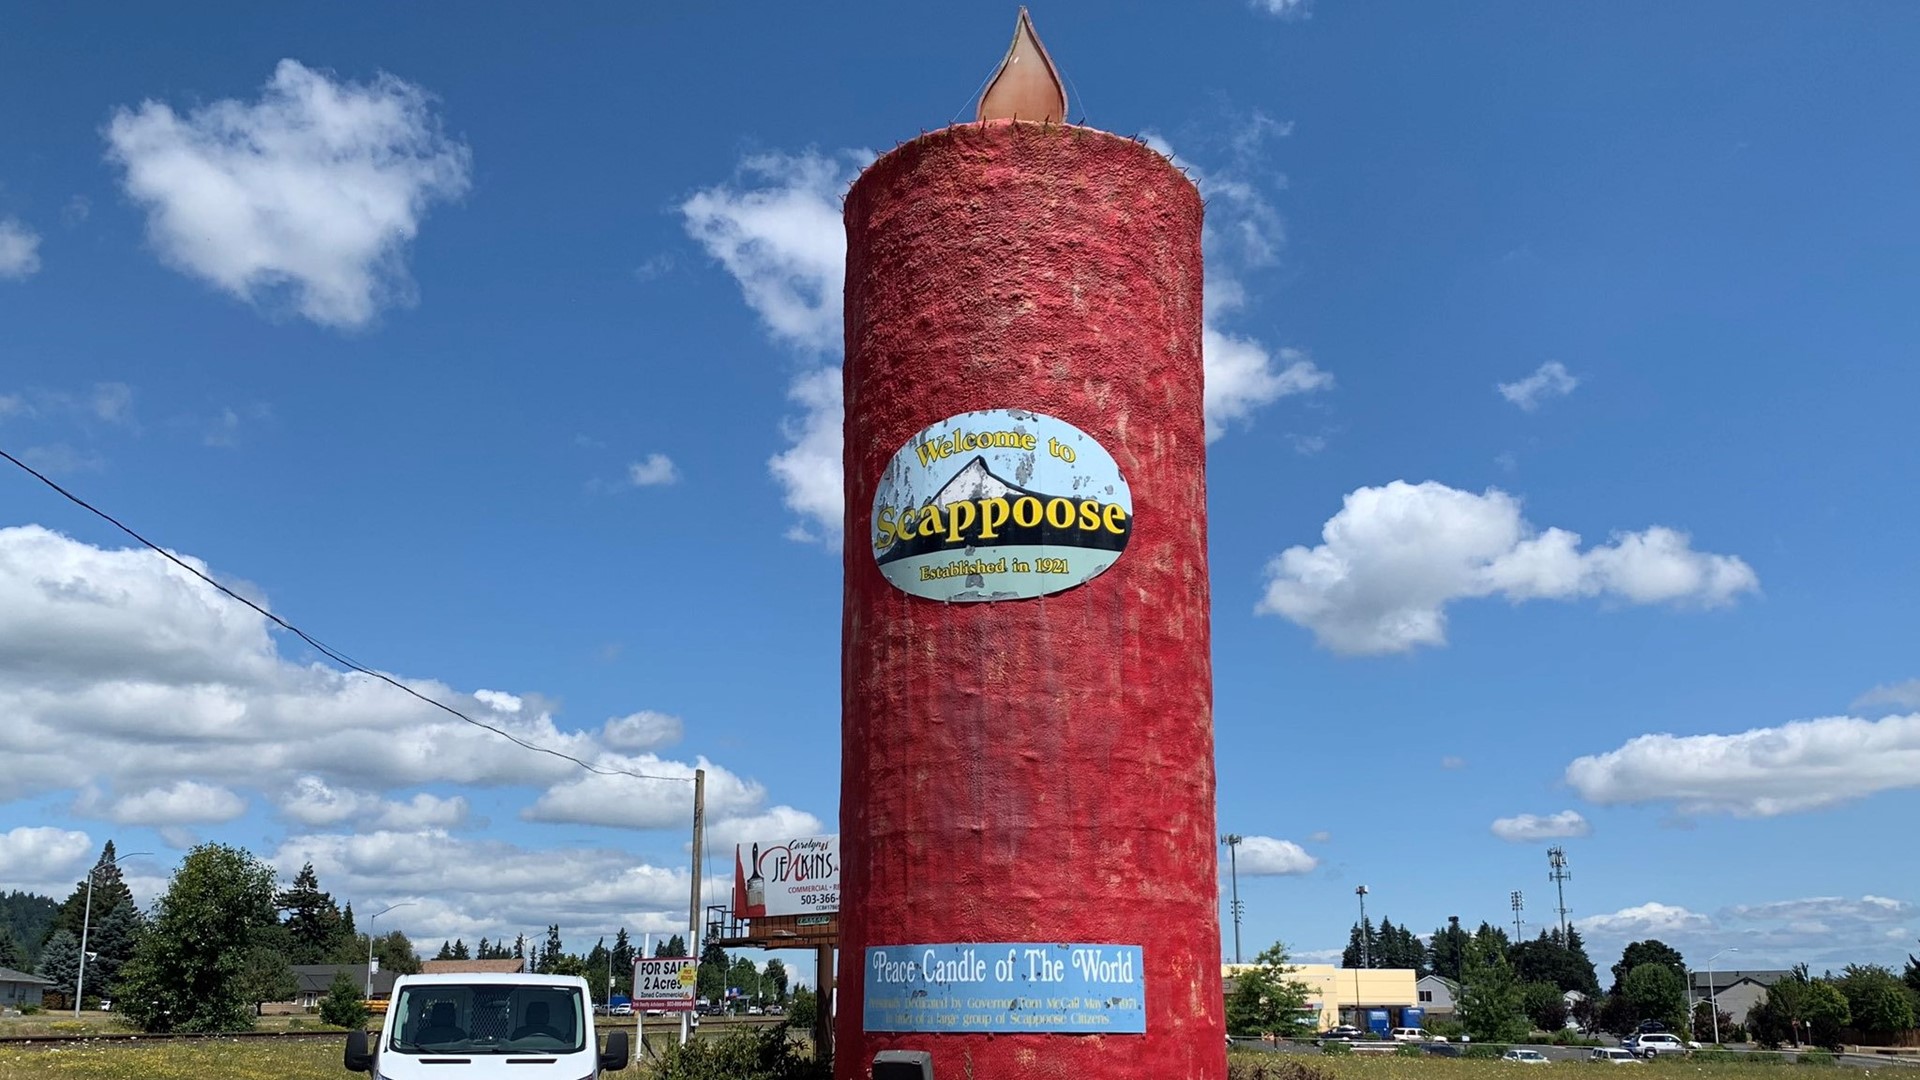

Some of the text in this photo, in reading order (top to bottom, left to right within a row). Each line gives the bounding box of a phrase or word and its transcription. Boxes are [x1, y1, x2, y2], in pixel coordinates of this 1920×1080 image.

[915, 428, 1077, 468] Welcome to
[875, 495, 1126, 549] Scappoose
[919, 558, 1070, 582] Established in 1921
[764, 847, 833, 882] JENKINS
[788, 885, 828, 894] COMMERCIAL
[641, 962, 661, 975] FOR
[872, 948, 1134, 983] Peace Candle of The World
[644, 976, 650, 990] 2
[652, 976, 682, 990] Acres
[951, 997, 962, 1011] by
[1047, 997, 1080, 1008] McCall
[1084, 998, 1102, 1011] May
[962, 1014, 992, 1027] group
[995, 1013, 1006, 1024] of
[1010, 1014, 1067, 1026] Scappoose
